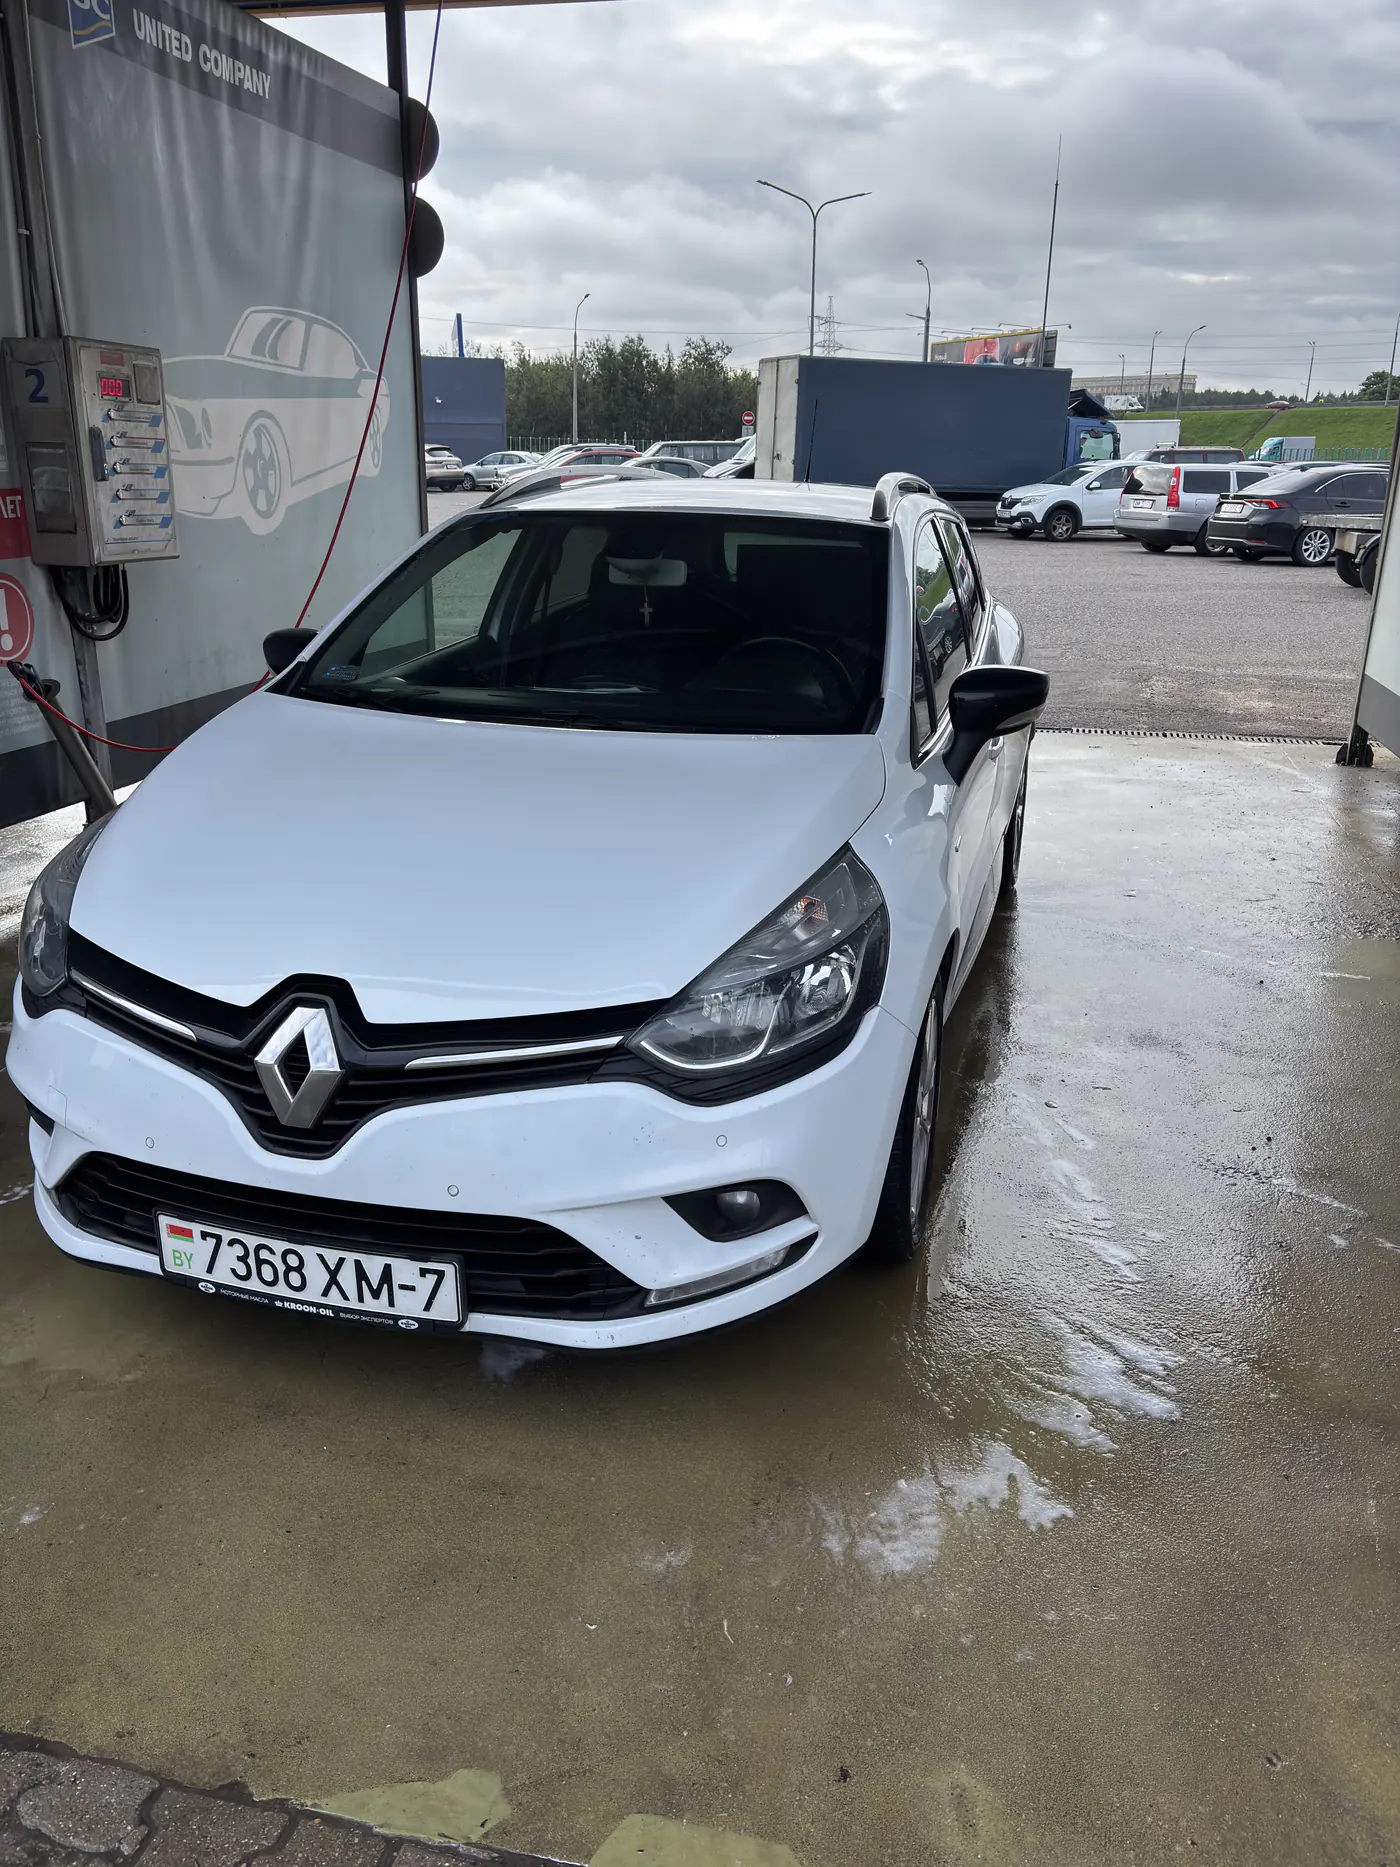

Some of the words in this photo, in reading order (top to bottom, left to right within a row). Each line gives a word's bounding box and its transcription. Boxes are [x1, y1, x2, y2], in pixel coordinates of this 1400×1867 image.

[132, 8, 192, 63] UNITED
[199, 43, 271, 99] COMPANY
[24, 368, 49, 403] 2
[100, 378, 123, 397] 000
[172, 1249, 194, 1270] BY
[200, 1229, 307, 1293] 7368
[315, 1252, 446, 1312] XM-7
[220, 1288, 250, 1301] МОТОРНЫЕ
[249, 1295, 269, 1304] МАСЛА
[339, 1312, 361, 1321] ВЫБОР
[360, 1315, 394, 1325] ЭКСПЕРТОВ
